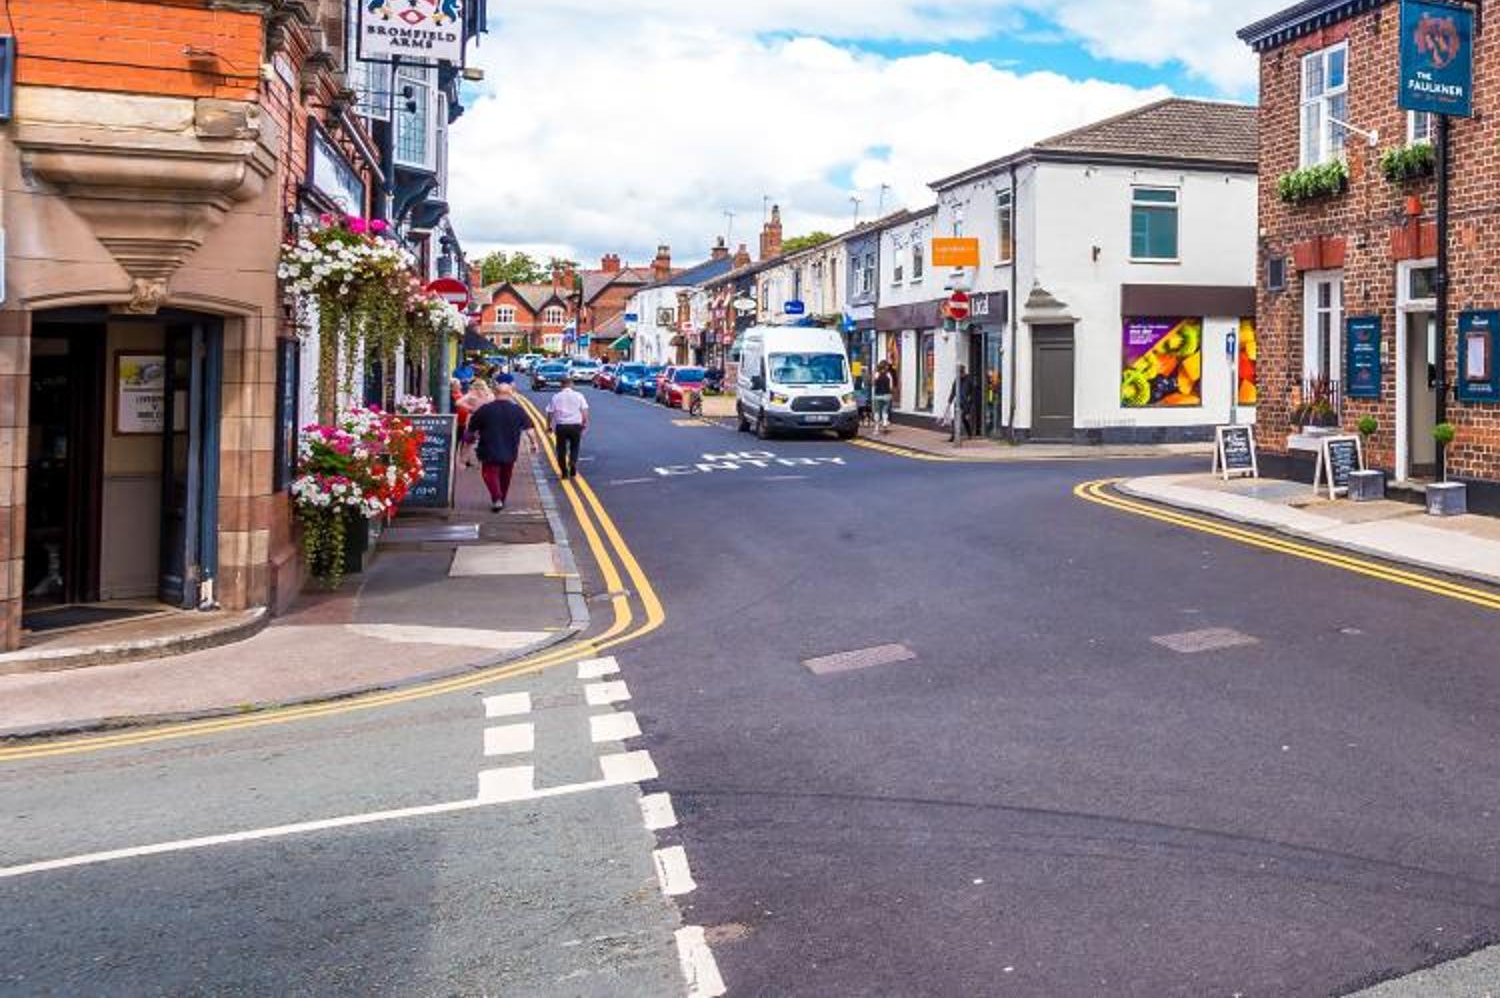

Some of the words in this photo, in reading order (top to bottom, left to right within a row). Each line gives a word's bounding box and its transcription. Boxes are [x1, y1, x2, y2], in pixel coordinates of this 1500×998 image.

[367, 25, 456, 42] BROMFIELD
[390, 37, 432, 48] ARMS
[1416, 71, 1432, 81] THE
[1408, 79, 1463, 97] FAULKNER
